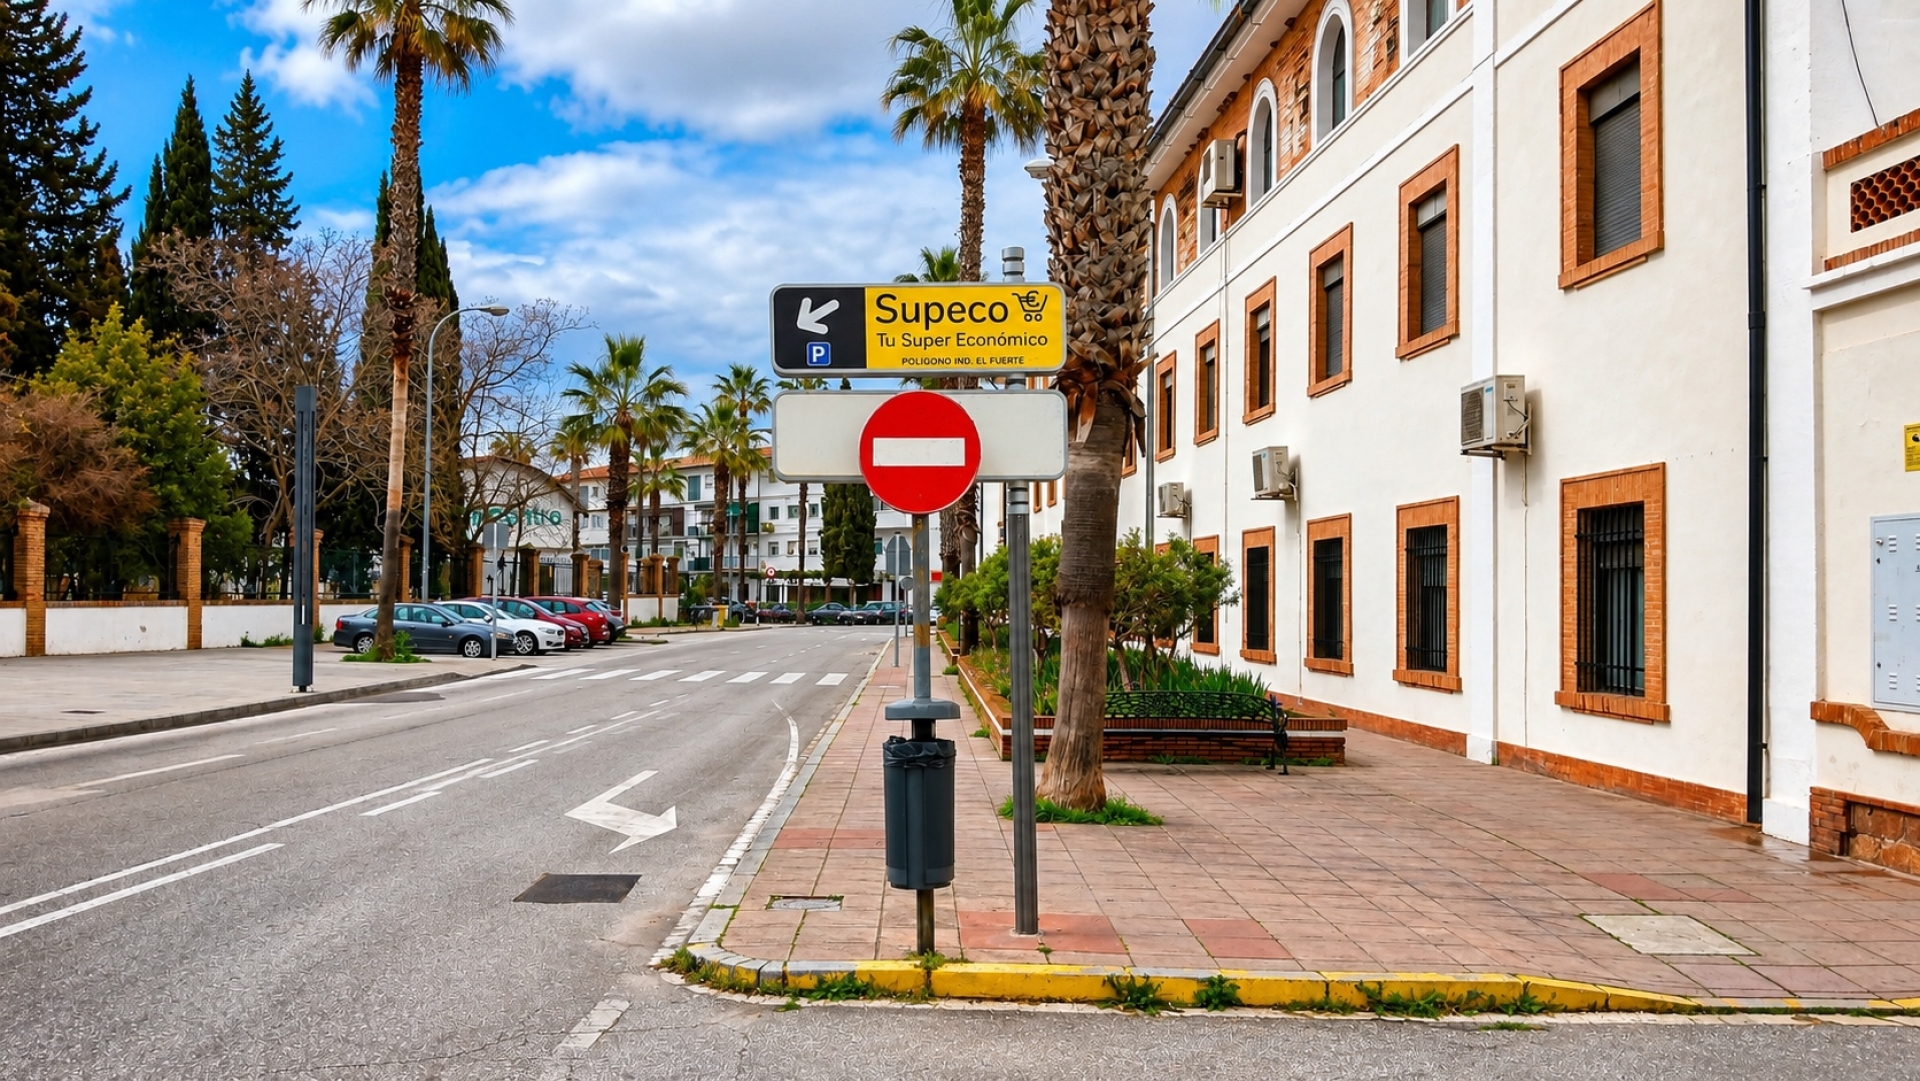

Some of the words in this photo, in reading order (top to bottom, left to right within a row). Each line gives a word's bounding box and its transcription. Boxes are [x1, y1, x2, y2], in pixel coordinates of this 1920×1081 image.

[875, 293, 1009, 331] Supeco
[876, 332, 896, 347] Tu
[901, 332, 951, 350] Super
[956, 331, 1048, 347] Económico
[811, 346, 825, 363] P
[901, 357, 951, 365] POLIGONO
[954, 357, 973, 365] IND.
[976, 356, 987, 365] EL
[990, 356, 1025, 365] FUERTE
